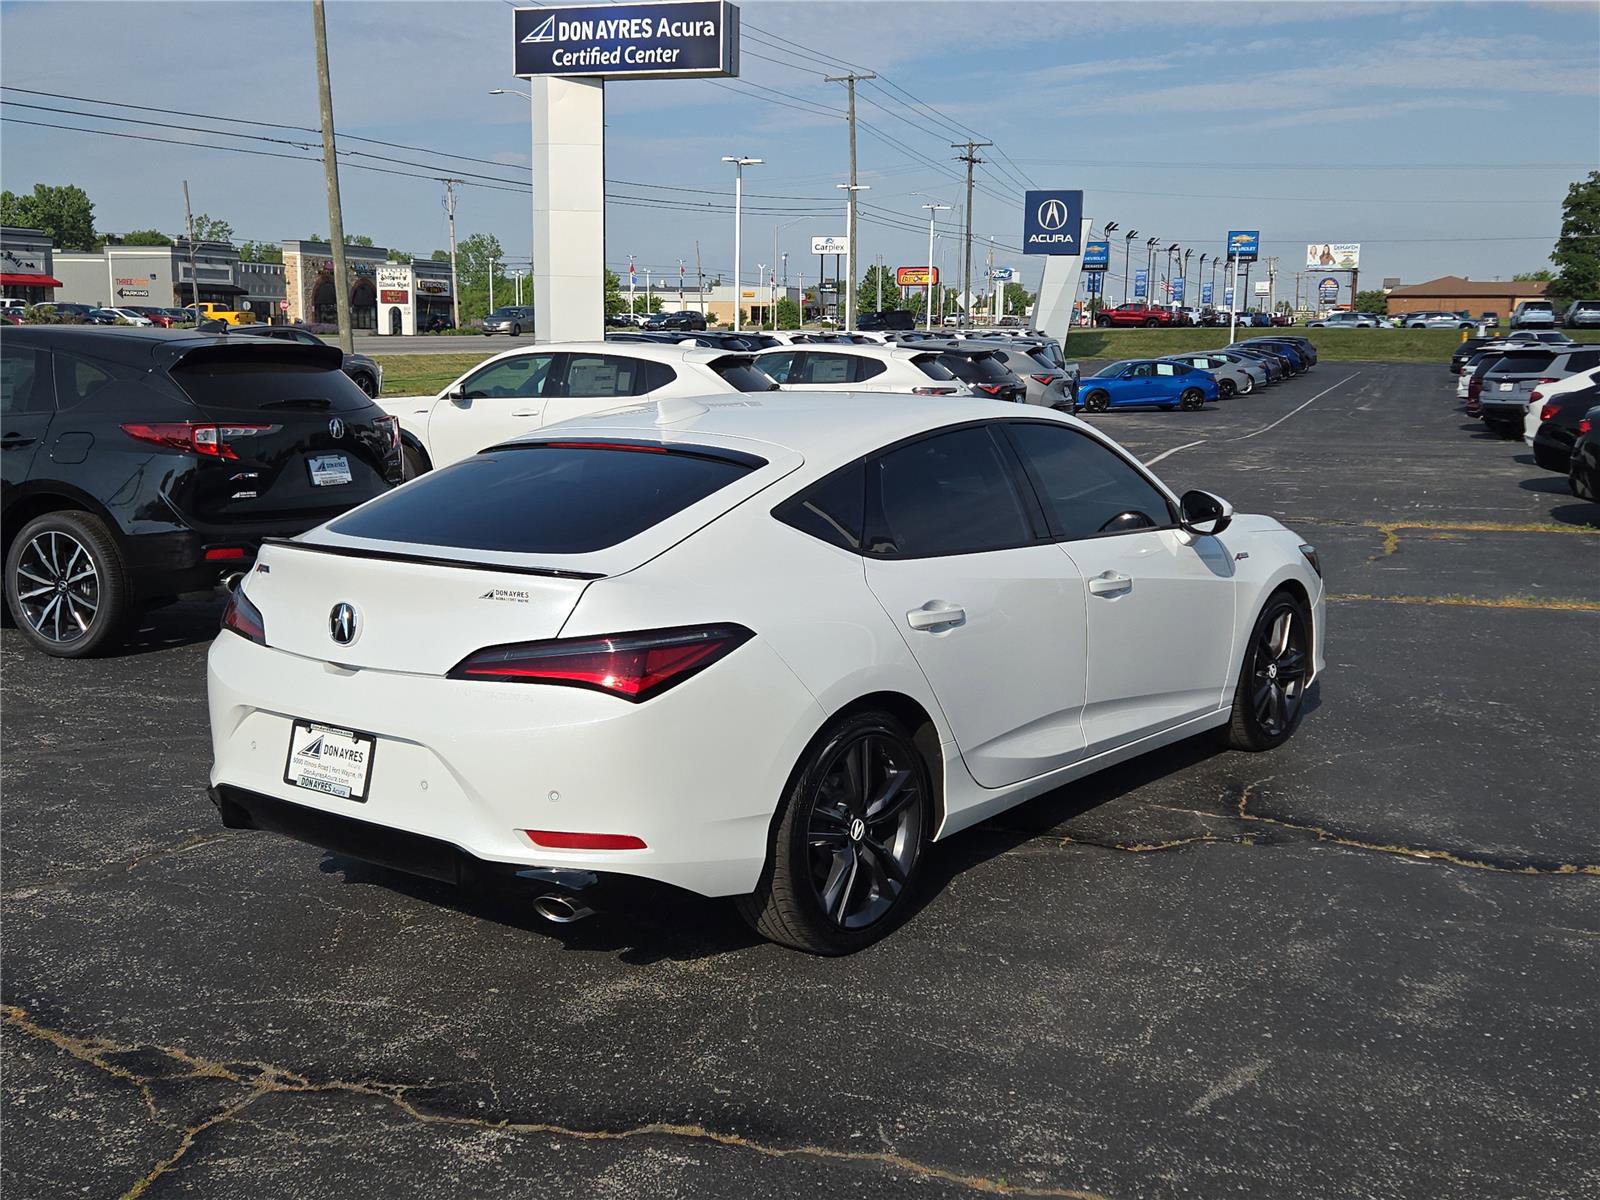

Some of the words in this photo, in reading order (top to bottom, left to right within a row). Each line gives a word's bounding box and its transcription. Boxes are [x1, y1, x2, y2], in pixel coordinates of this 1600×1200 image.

[559, 21, 593, 41] DON
[595, 18, 653, 39] AYRES
[656, 17, 715, 37] Acura
[552, 46, 622, 66] Certified
[624, 46, 680, 64] Center
[1028, 234, 1074, 243] ACURA
[814, 244, 845, 252] Carplex
[324, 745, 339, 757] DON
[340, 748, 363, 763] AYRES
[301, 778, 314, 787] DON
[313, 781, 332, 791] AYRES
